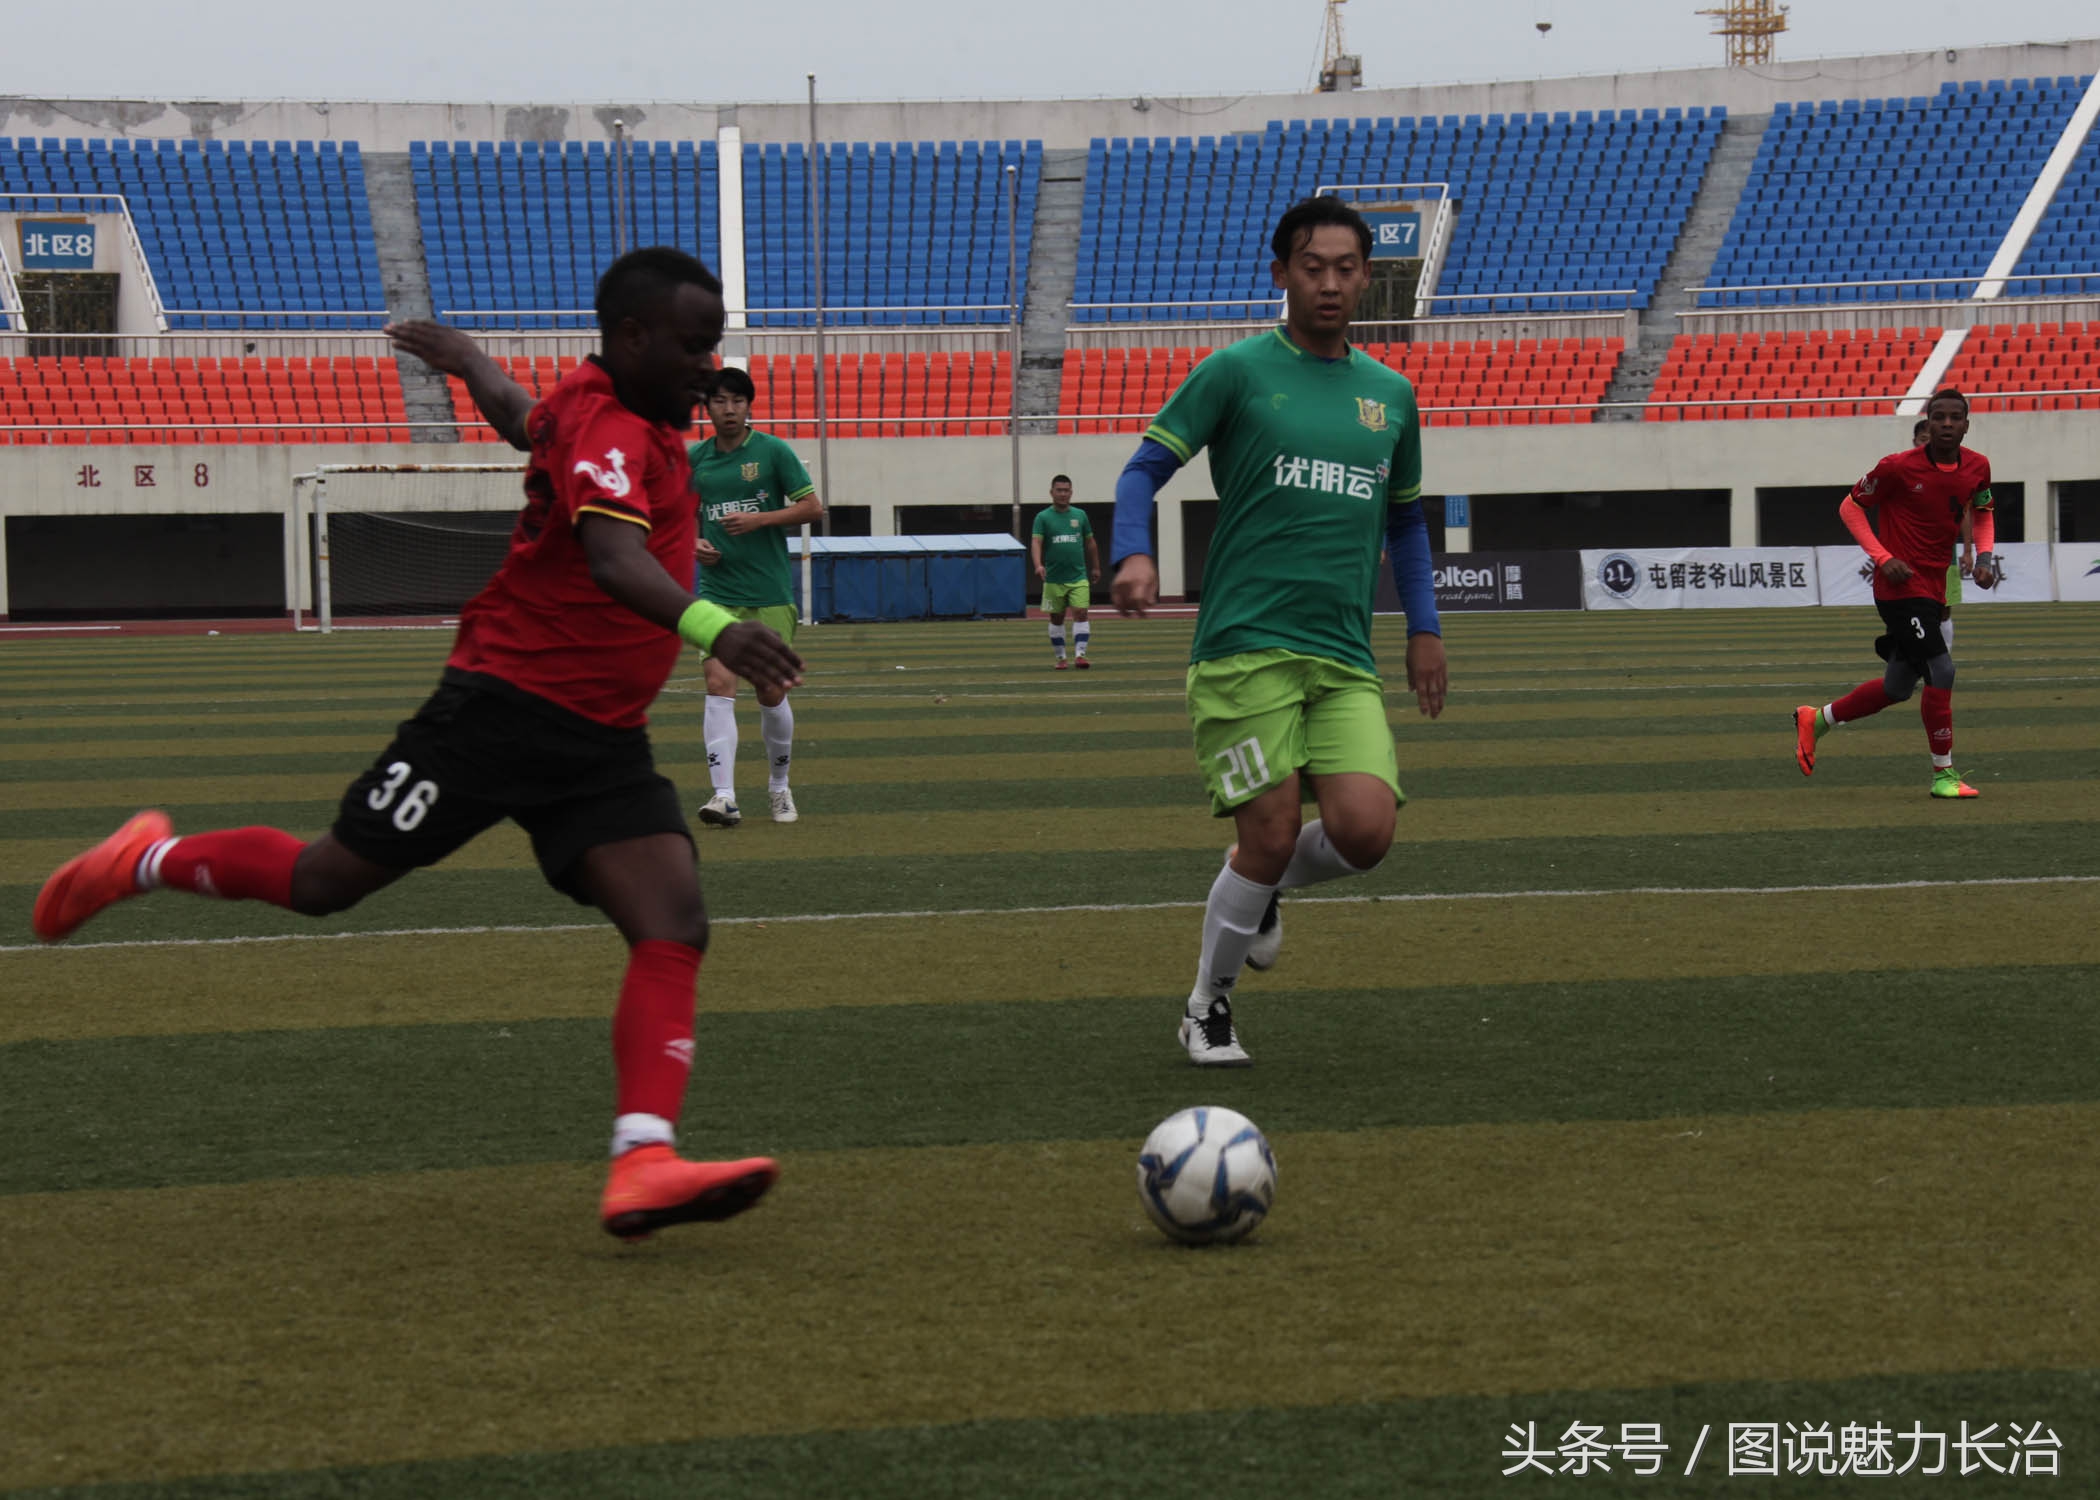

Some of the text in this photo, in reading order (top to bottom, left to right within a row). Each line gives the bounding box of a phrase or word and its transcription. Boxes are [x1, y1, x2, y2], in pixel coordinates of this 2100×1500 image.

[24, 233, 93, 256] 北区8
[1368, 223, 1417, 245] 区7
[1273, 454, 1377, 500] 优朋云
[1431, 566, 1494, 588] olten
[1648, 562, 1807, 589] 屯留老爷山风景区
[1911, 616, 1925, 640] 3
[1215, 735, 1270, 799] 20
[367, 761, 438, 831] 36
